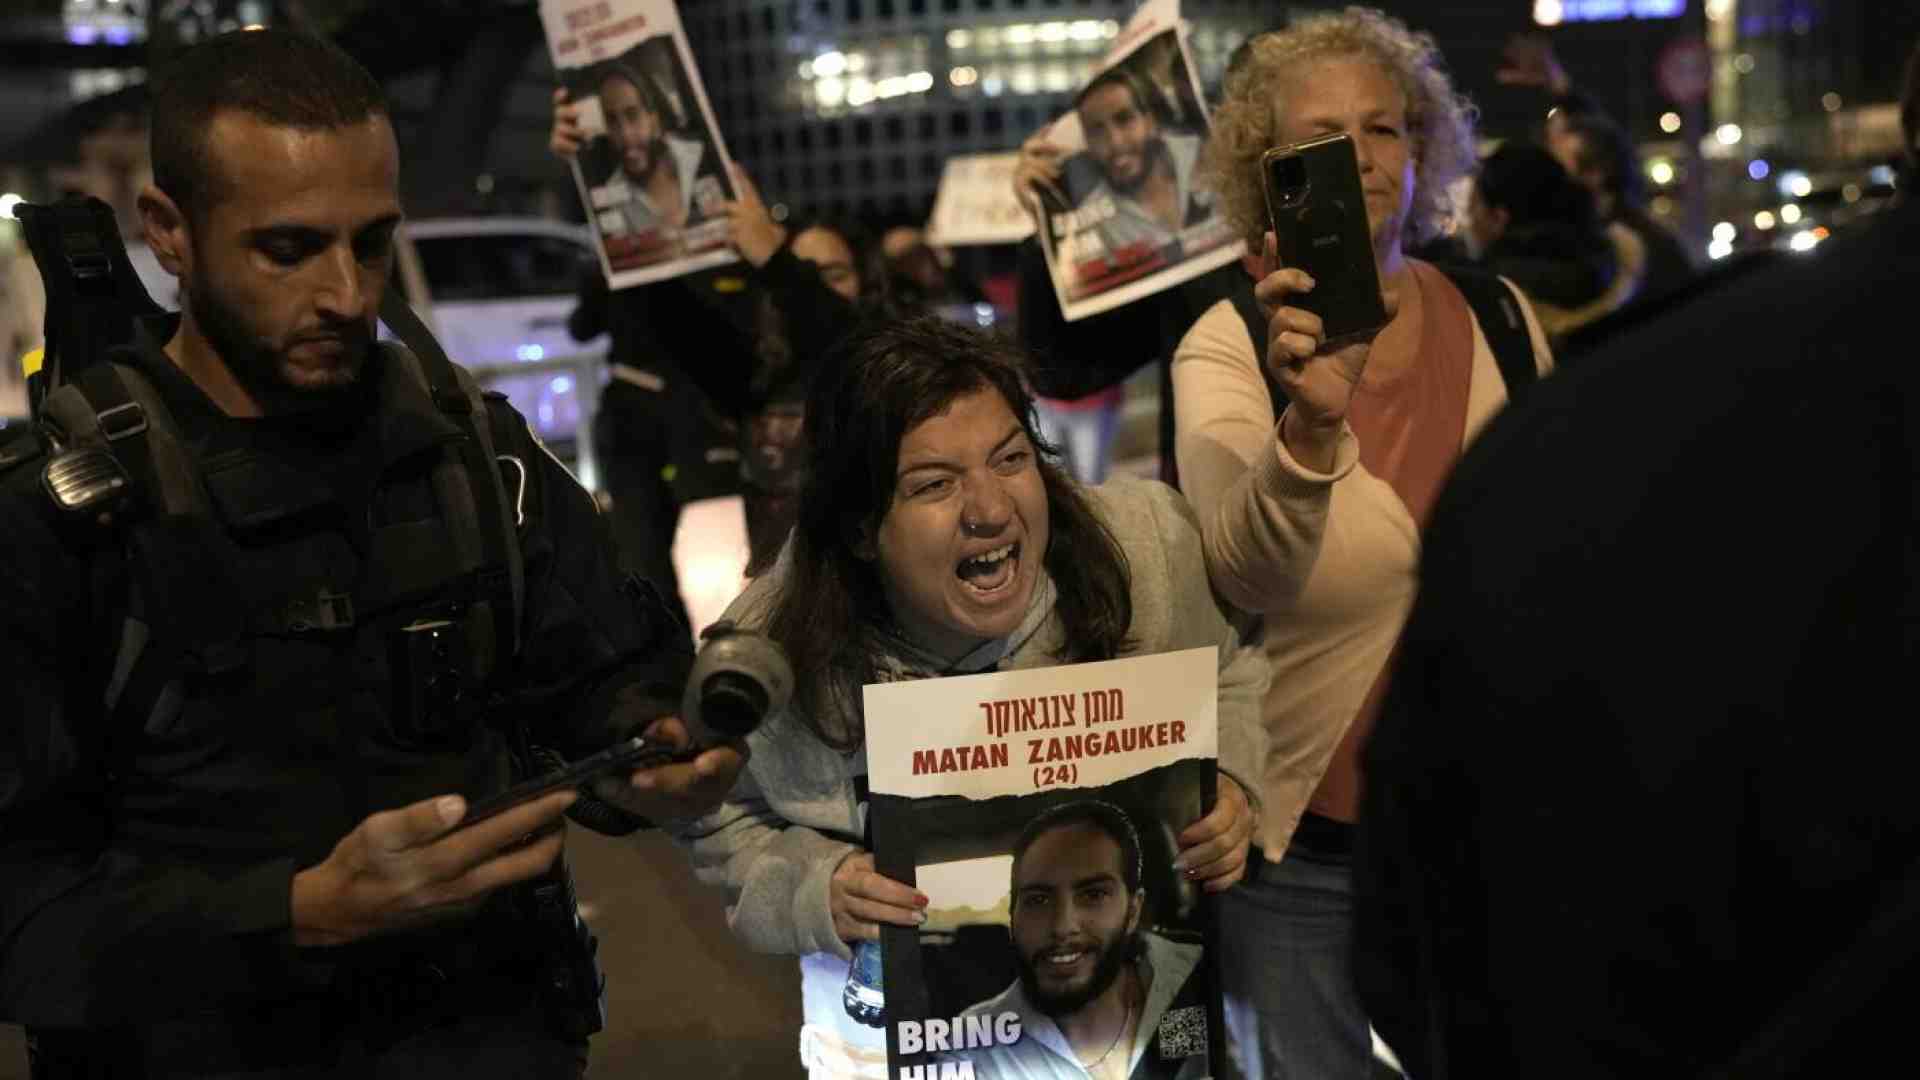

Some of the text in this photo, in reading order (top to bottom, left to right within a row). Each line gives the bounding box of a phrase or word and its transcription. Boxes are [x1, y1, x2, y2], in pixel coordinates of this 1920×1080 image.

[979, 688, 1123, 738] מתן צנגאוקר
[912, 720, 1186, 775] MATAN ZANGAUKER
[1034, 764, 1078, 788] (24)
[898, 1011, 1021, 1055] BRING
